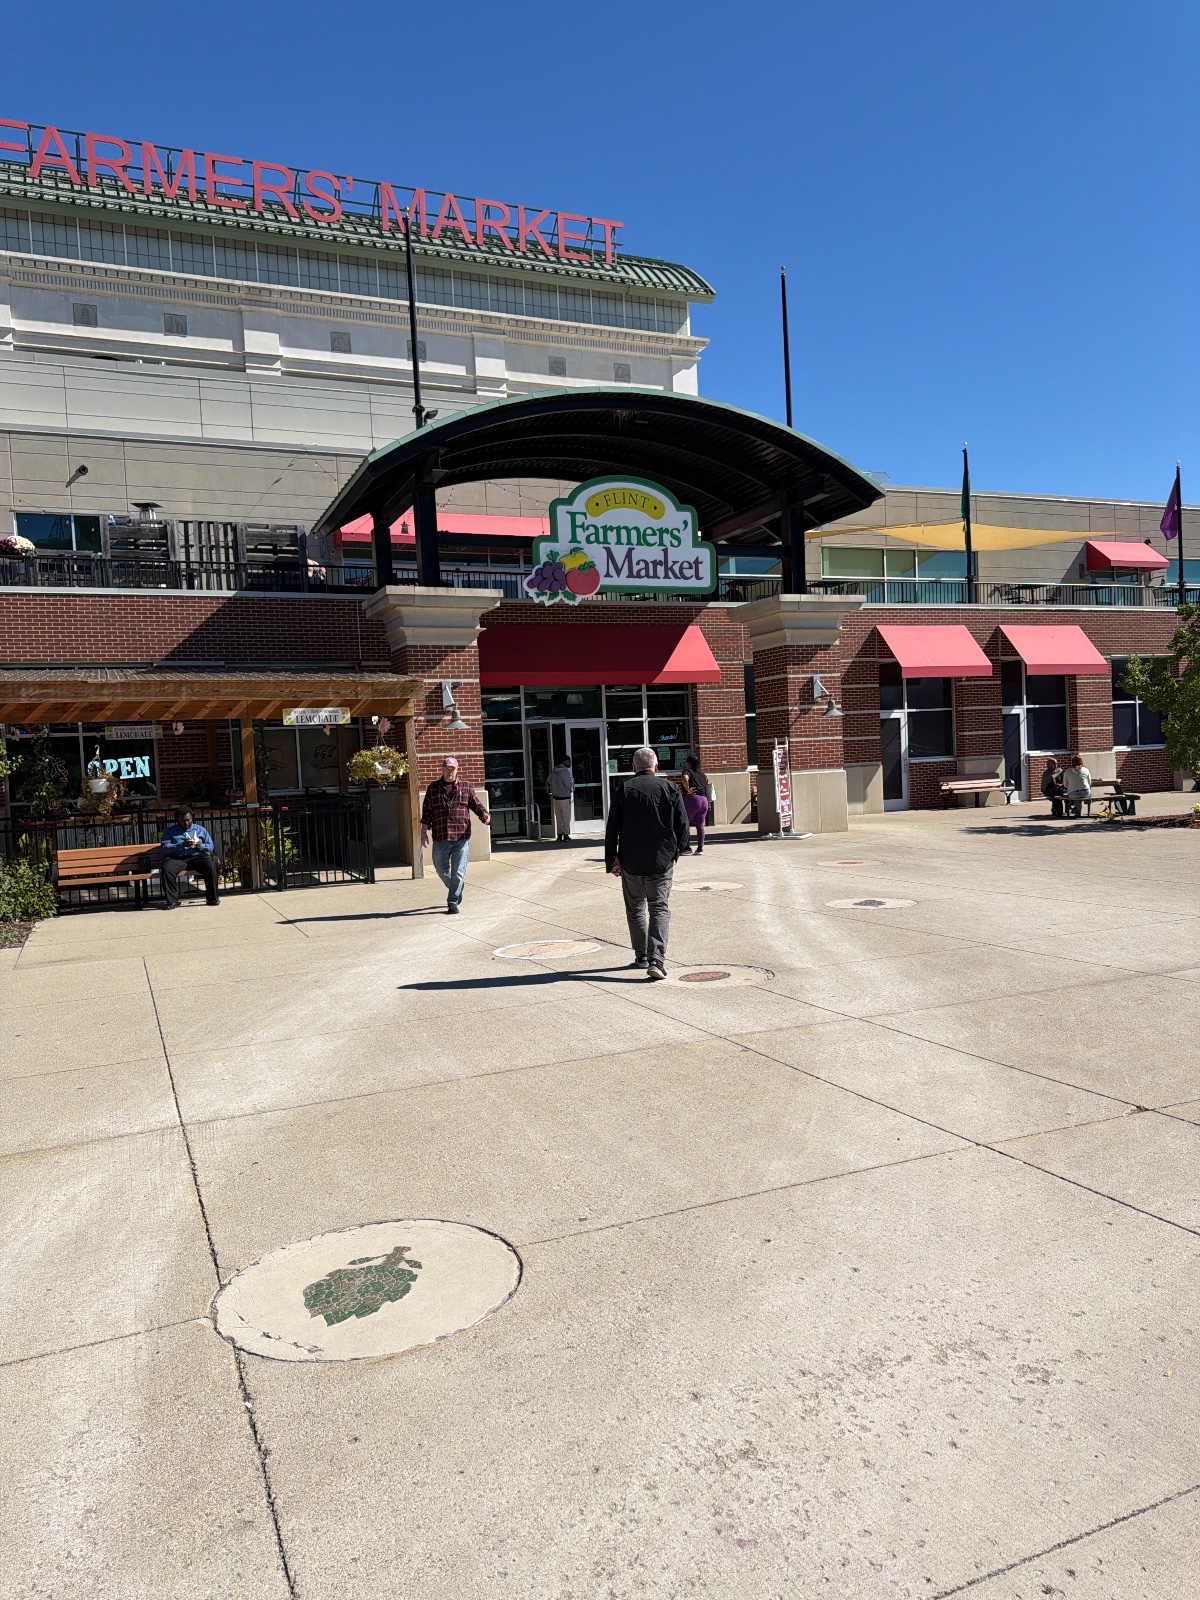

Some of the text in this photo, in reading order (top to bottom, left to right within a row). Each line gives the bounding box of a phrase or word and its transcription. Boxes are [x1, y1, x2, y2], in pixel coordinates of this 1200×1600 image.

[380, 182, 623, 265] MARKET
[603, 492, 649, 508] FLINT
[567, 511, 688, 547] Farmers'
[603, 546, 704, 580] Market
[295, 714, 339, 723] LEMONADE
[87, 756, 150, 779] OPEN
